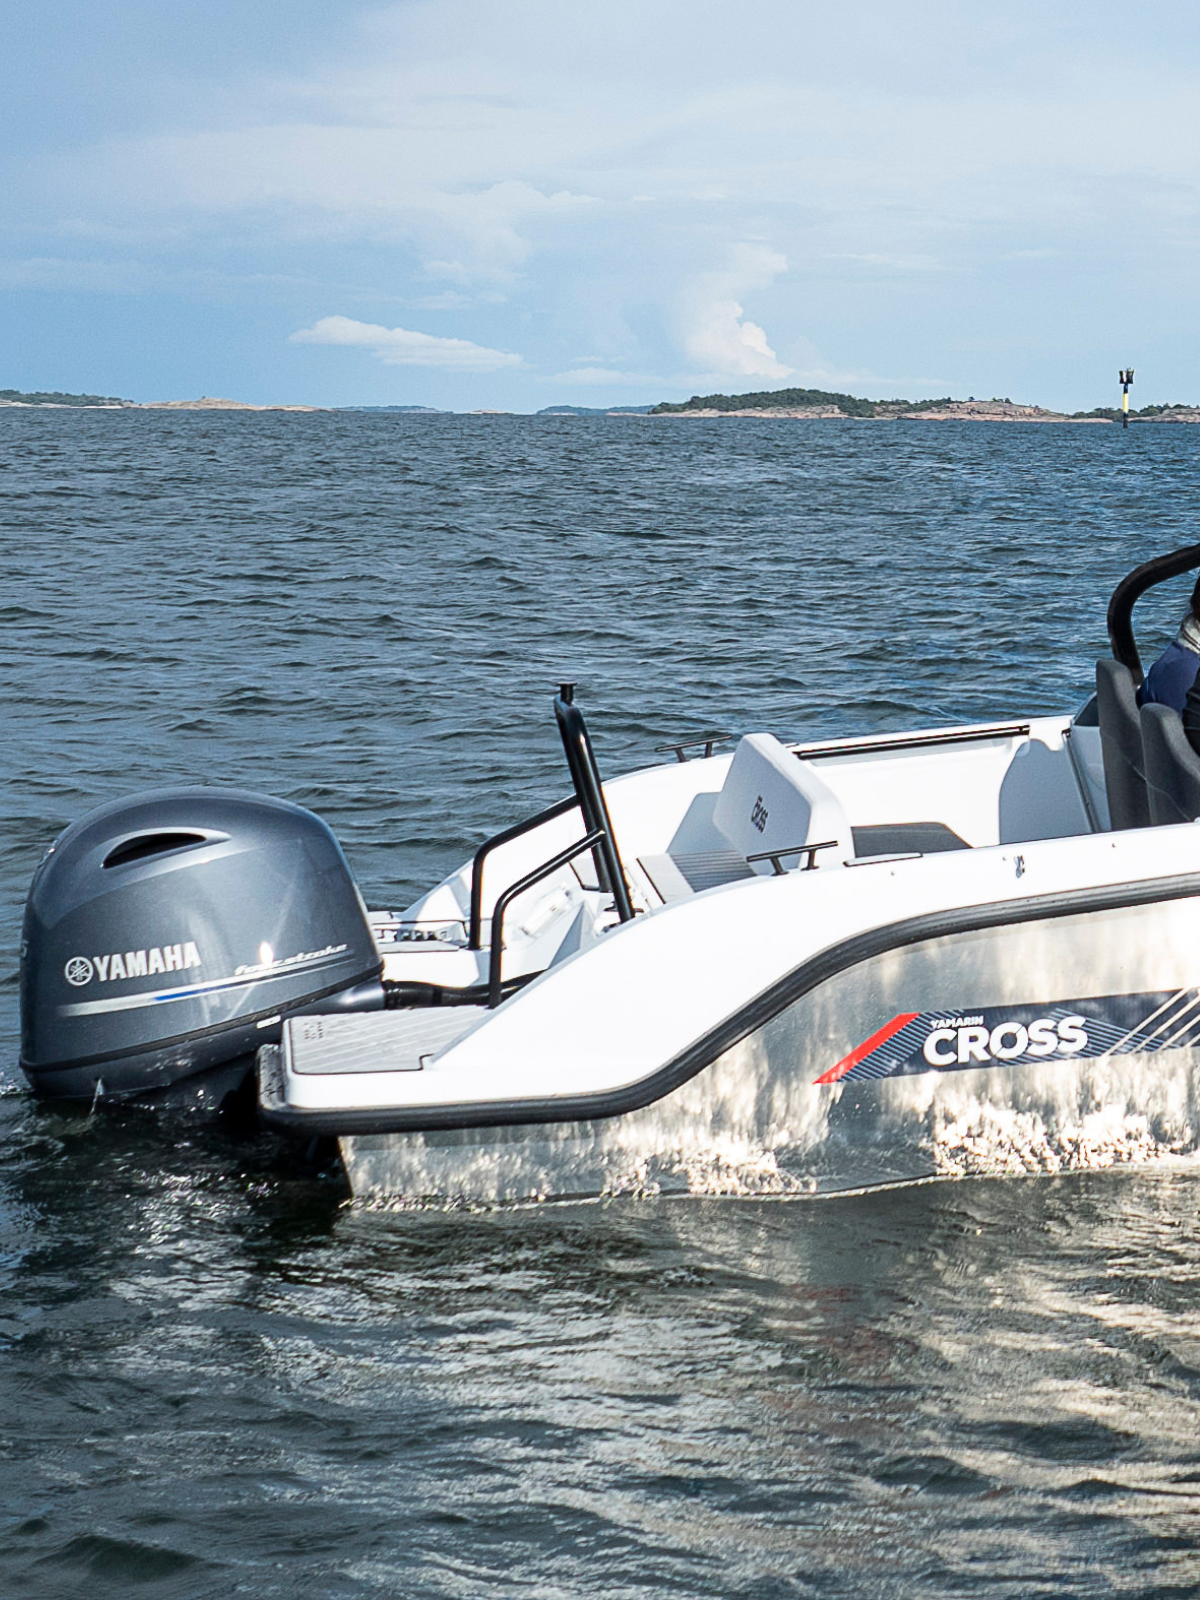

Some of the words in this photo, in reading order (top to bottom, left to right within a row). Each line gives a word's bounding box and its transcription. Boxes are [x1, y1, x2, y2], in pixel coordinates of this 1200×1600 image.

[92, 941, 202, 982] YAMAHA
[923, 1015, 1089, 1066] CROSS
[930, 1015, 984, 1030] YAMARIN
